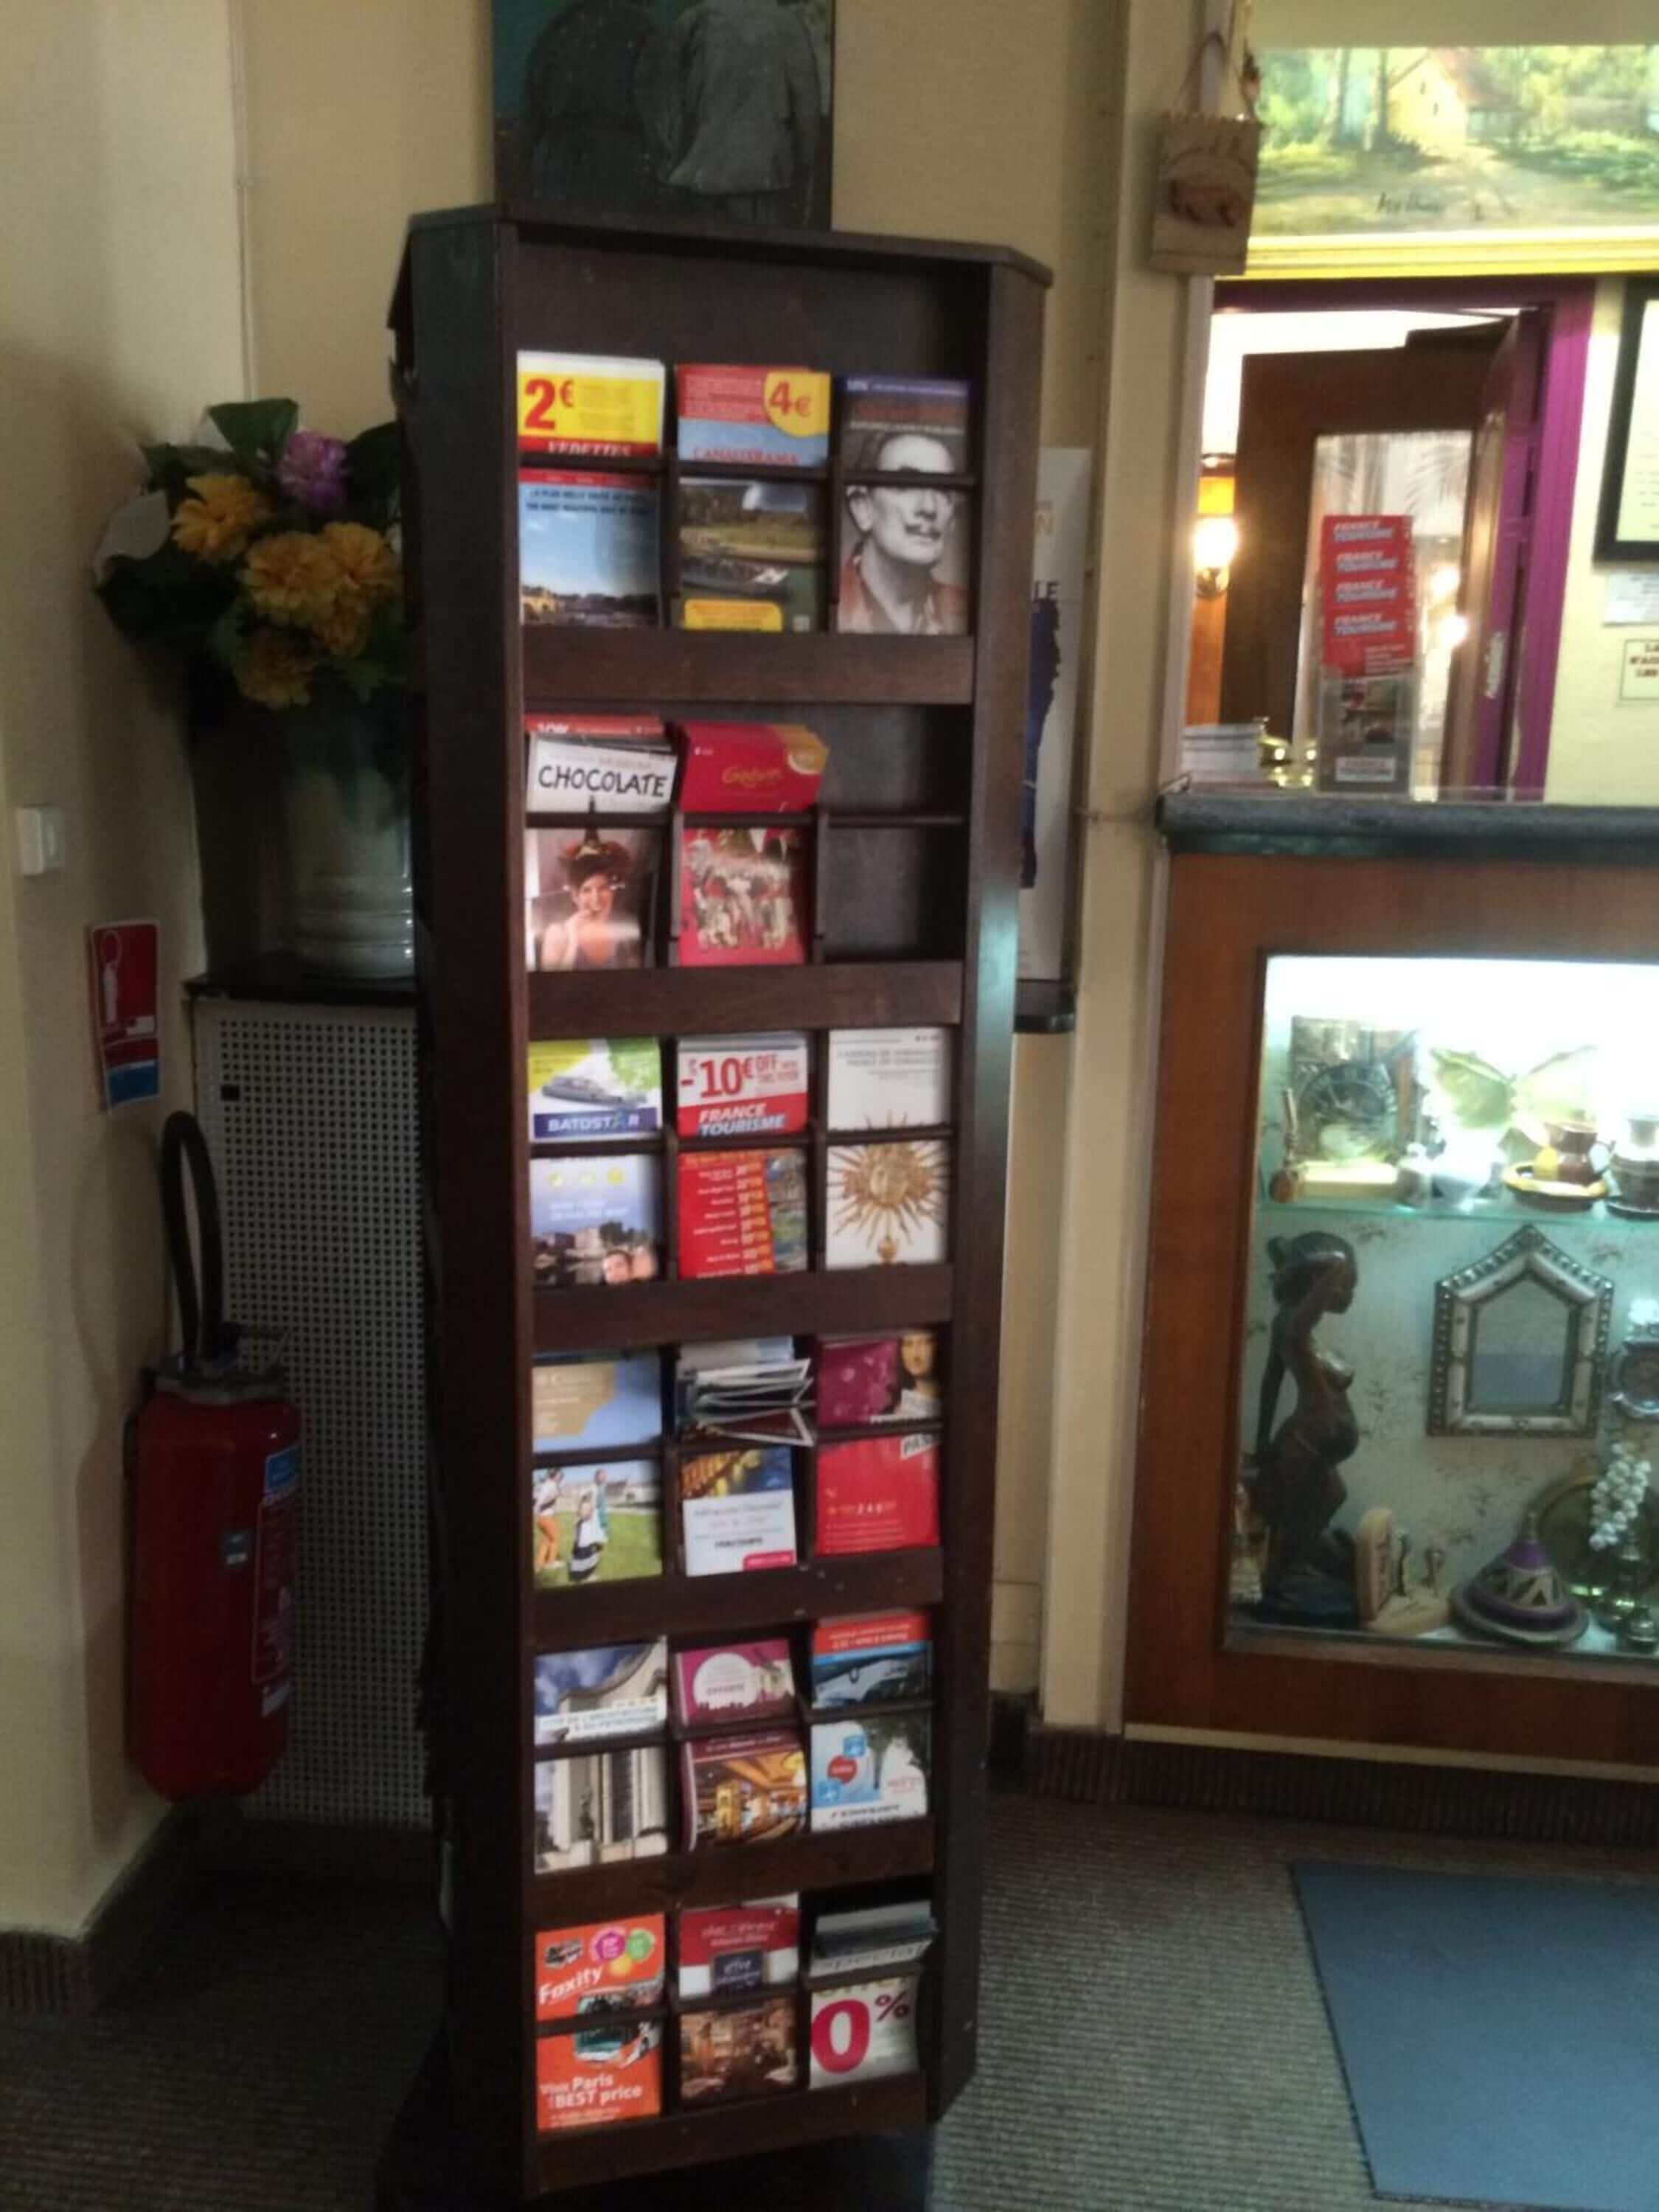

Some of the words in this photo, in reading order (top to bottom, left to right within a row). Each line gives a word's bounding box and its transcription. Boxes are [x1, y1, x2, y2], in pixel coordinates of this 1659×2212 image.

[538, 764, 667, 798] CHOCOLATE
[698, 1113, 787, 1136] TOURISME
[699, 1103, 767, 1124] FRANCE
[538, 1965, 603, 2006] Foxity
[572, 2073, 613, 2091] Paris
[554, 2089, 595, 2109] BEST
[599, 2085, 642, 2107] price
